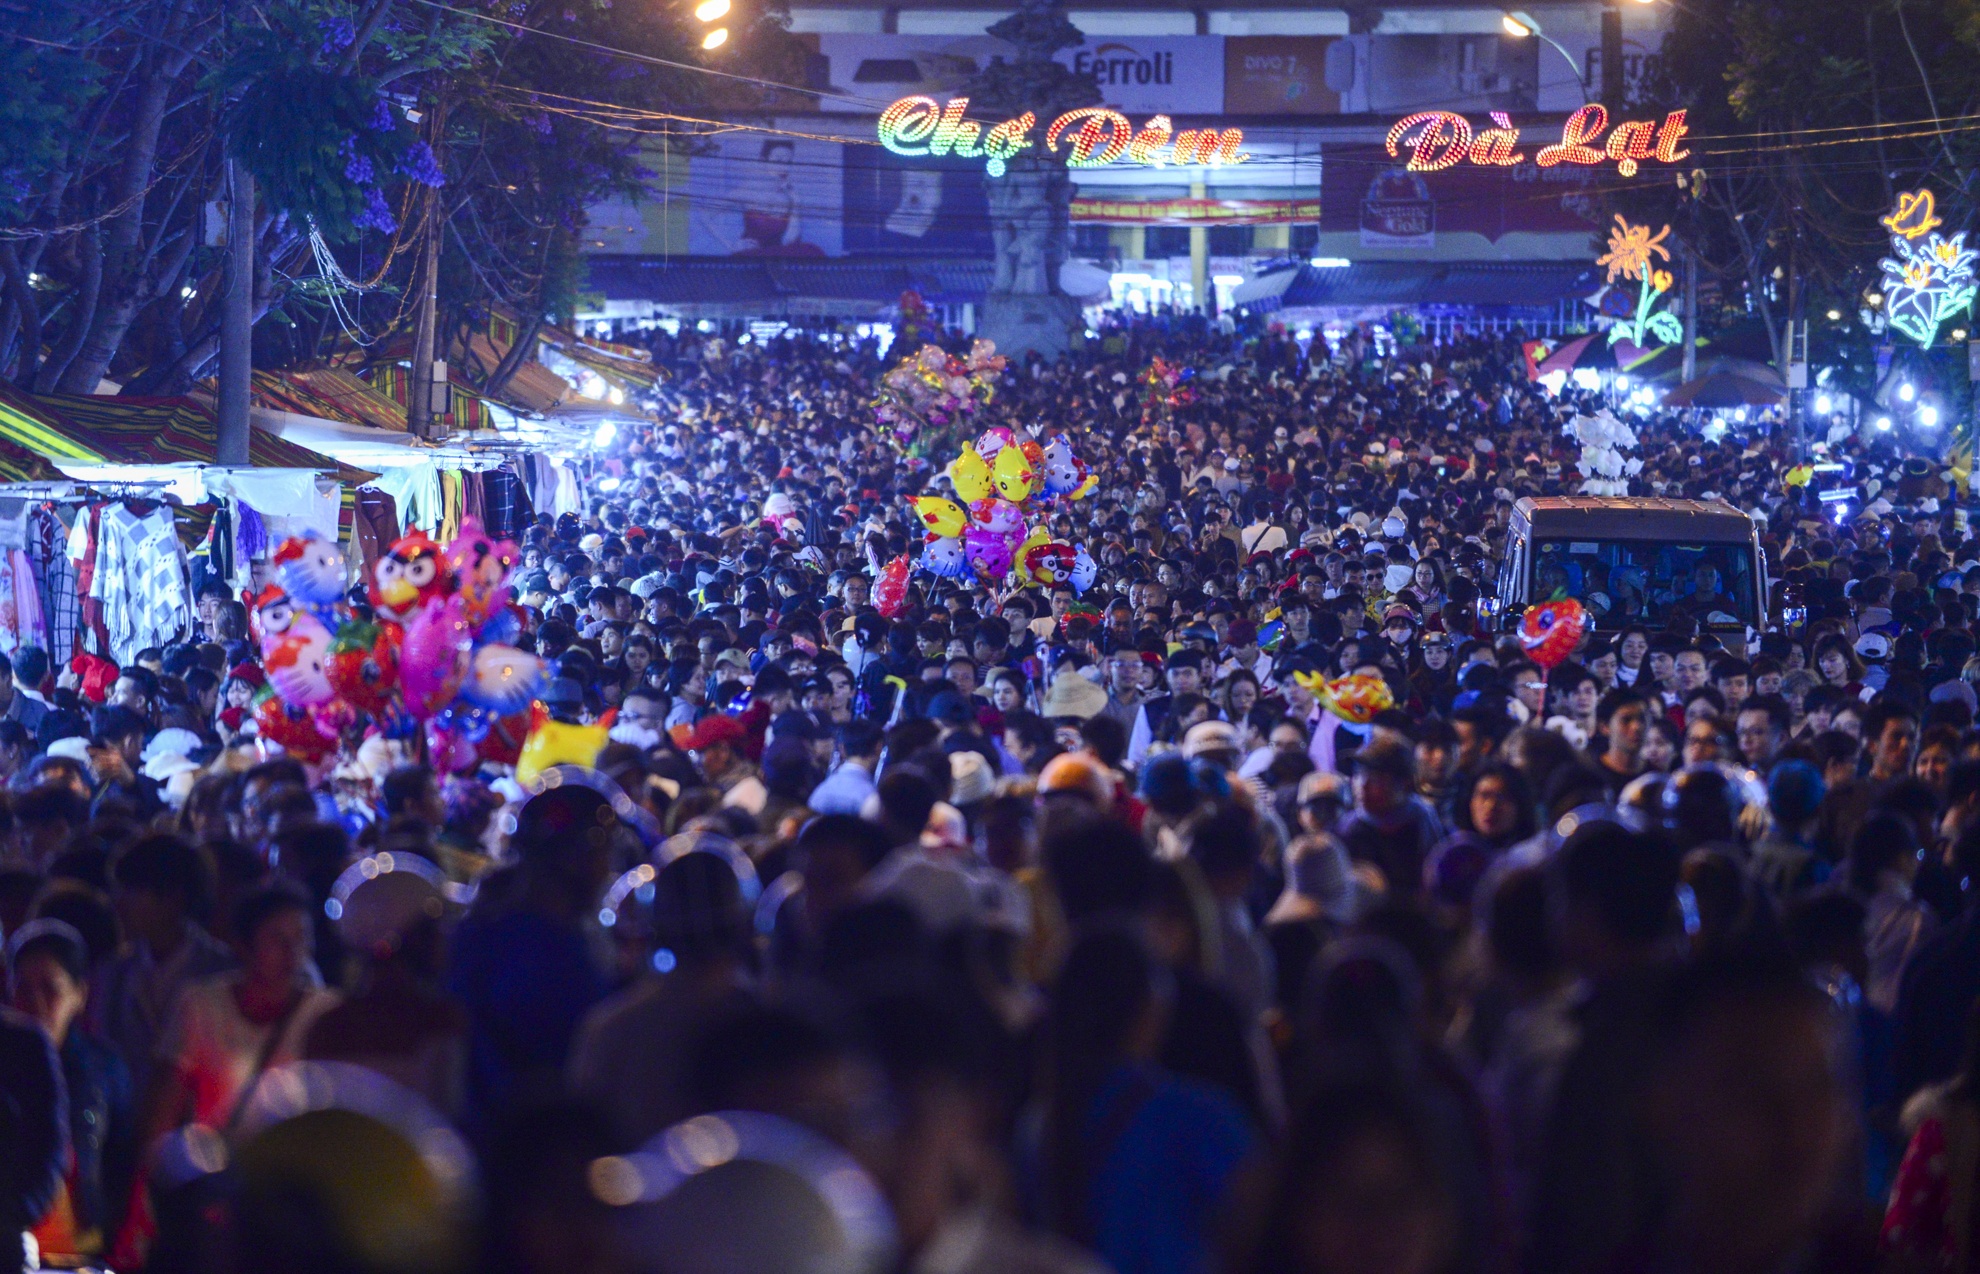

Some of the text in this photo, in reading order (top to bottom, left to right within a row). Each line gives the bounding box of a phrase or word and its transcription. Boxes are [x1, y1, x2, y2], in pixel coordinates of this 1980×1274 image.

[1075, 51, 1172, 85] Ferroli
[878, 95, 1690, 178] Chợ Đêm Đà Lạt
